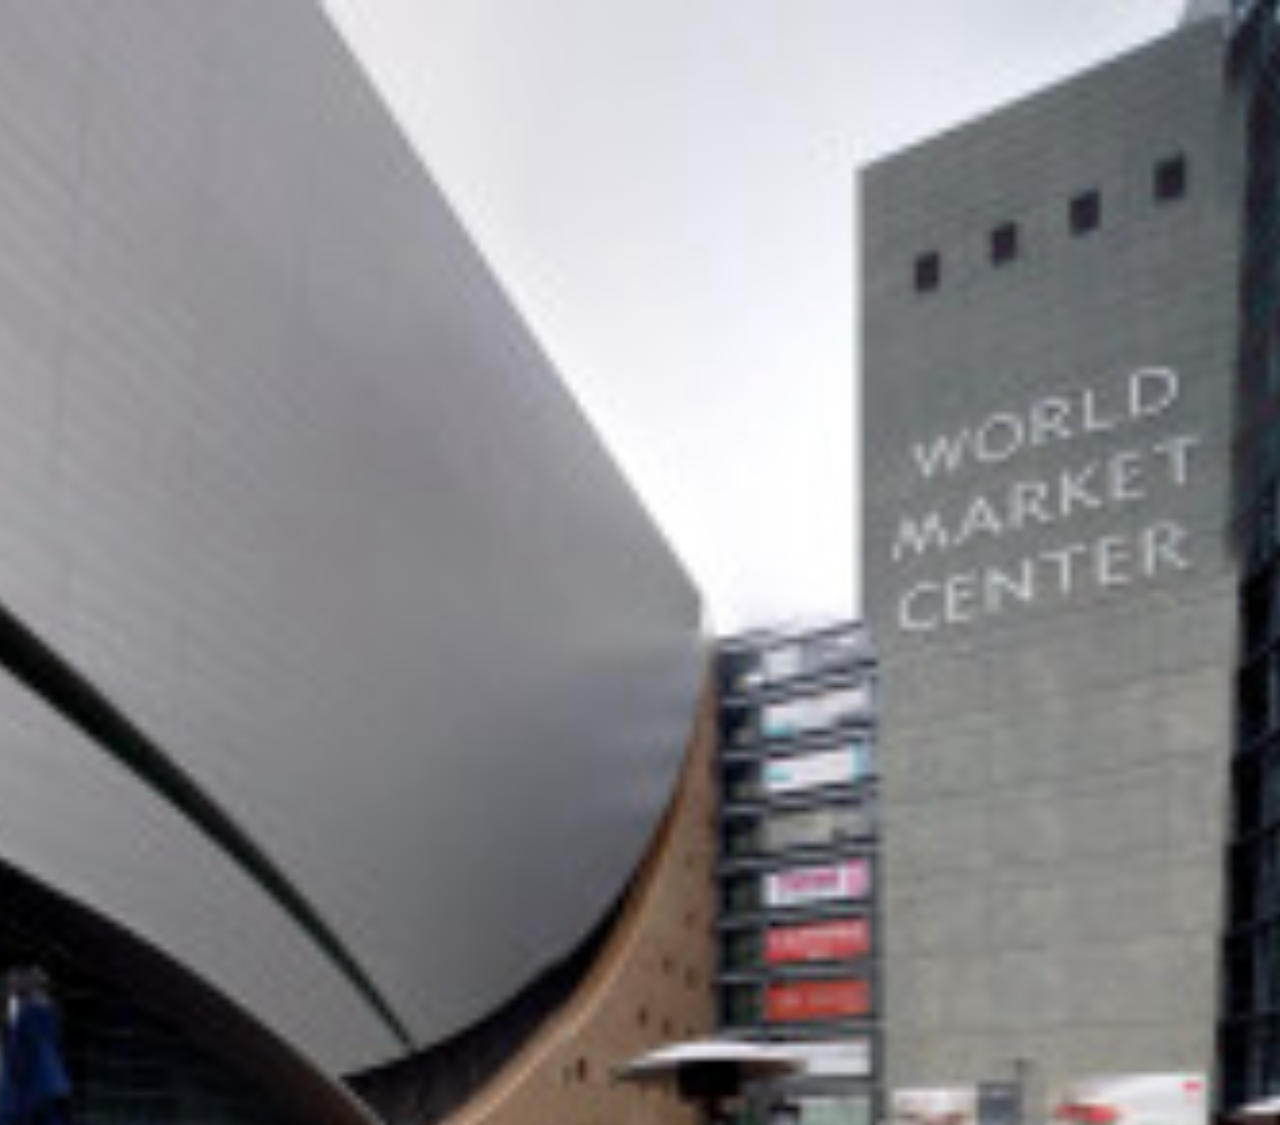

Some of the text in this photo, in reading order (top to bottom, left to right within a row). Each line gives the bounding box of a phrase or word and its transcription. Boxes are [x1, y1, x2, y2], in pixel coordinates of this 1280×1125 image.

[912, 366, 1179, 479] WORLD
[891, 433, 1200, 562] MARKET
[898, 519, 1190, 631] CENTER
